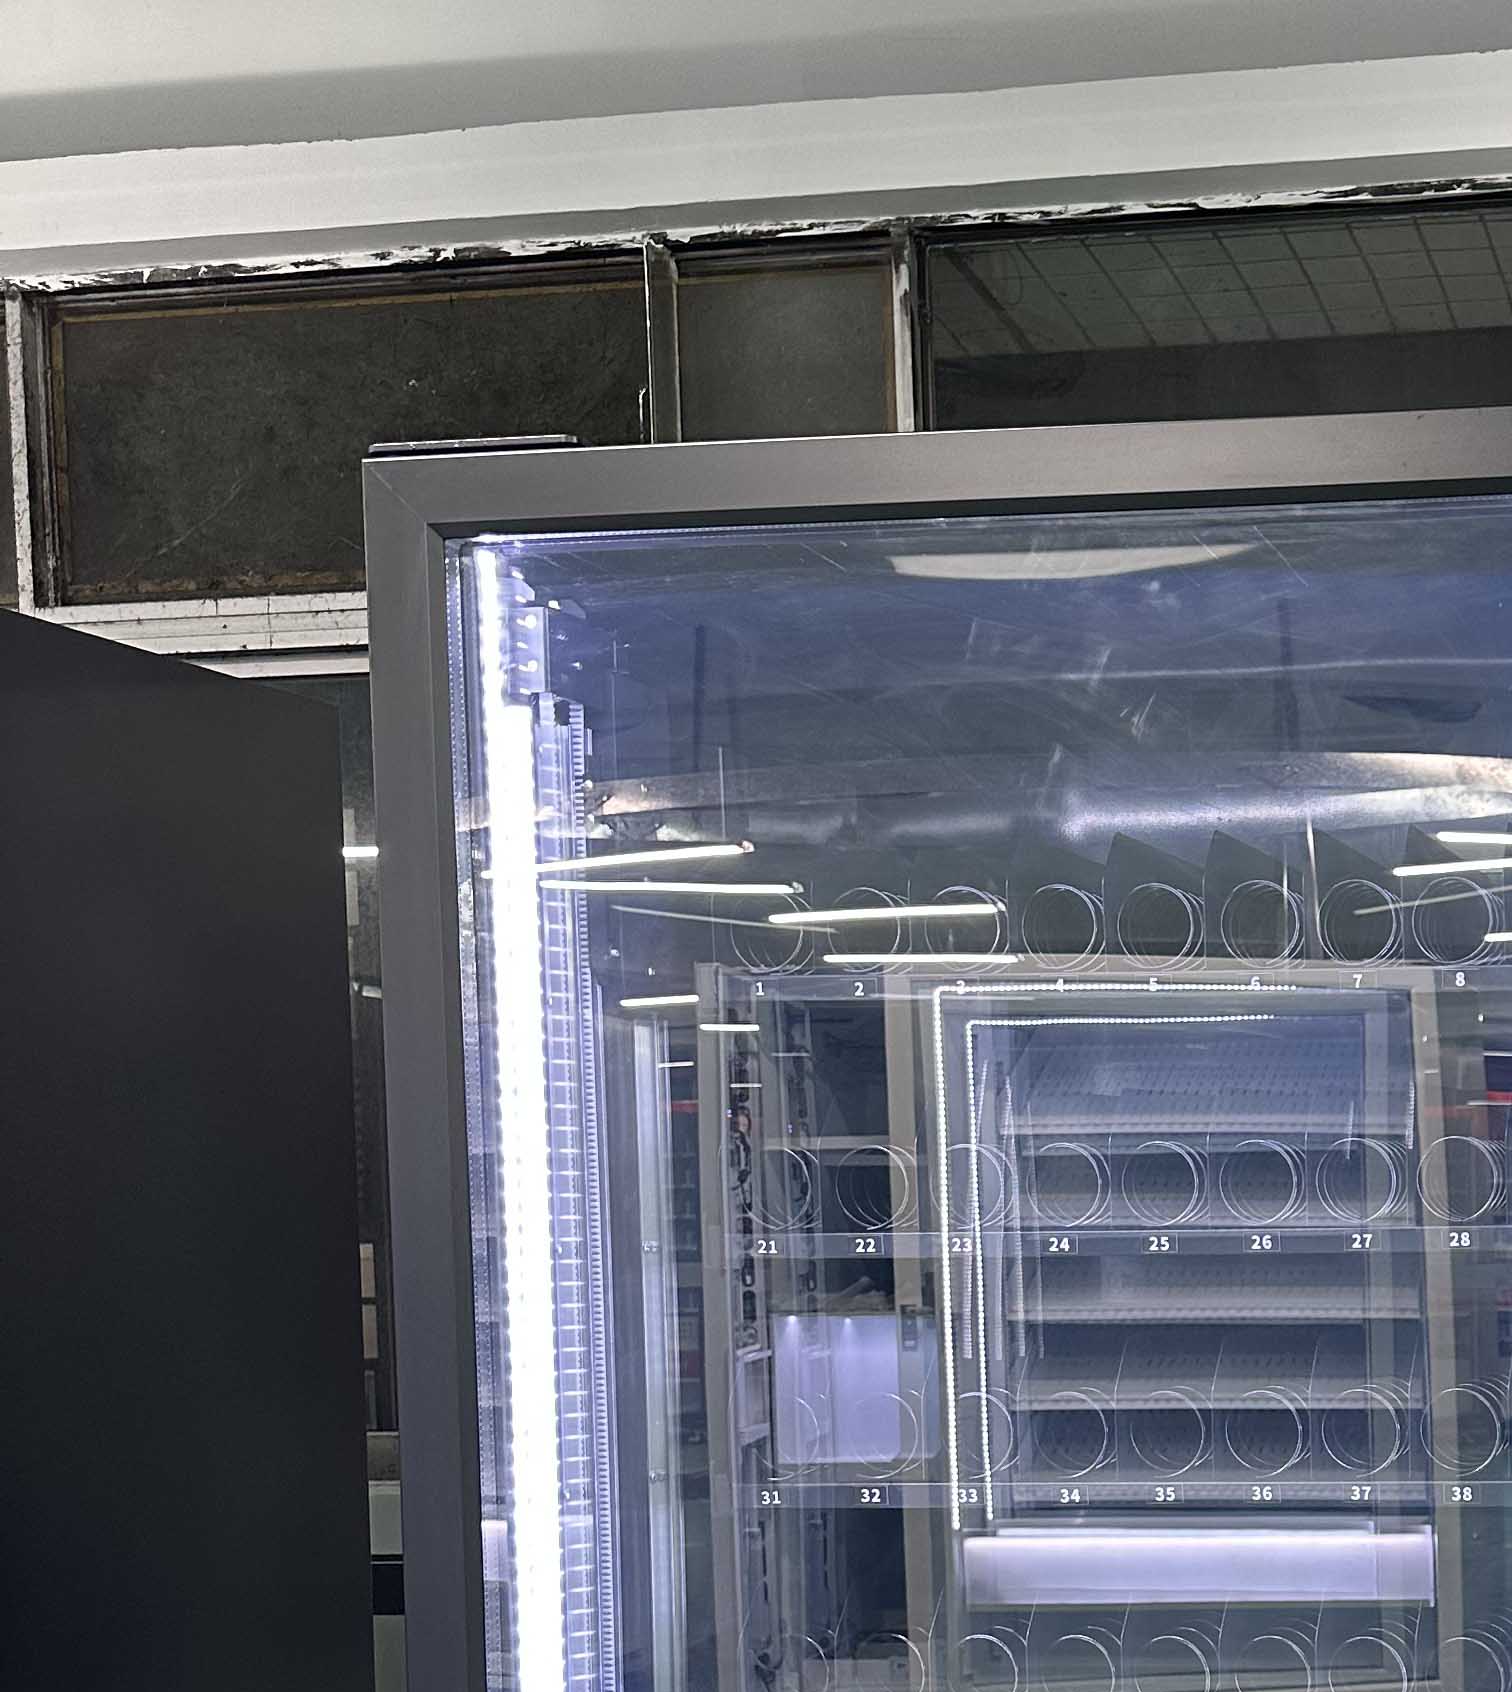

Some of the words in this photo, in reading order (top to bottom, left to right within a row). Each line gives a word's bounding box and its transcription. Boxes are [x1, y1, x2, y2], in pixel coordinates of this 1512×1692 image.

[1055, 979, 1065, 993] 4
[1149, 977, 1158, 991] 5
[1250, 976, 1260, 990] 6
[1352, 973, 1363, 989] 7
[1455, 971, 1466, 987] 8
[756, 981, 765, 996] 1
[854, 981, 865, 996] 2
[957, 981, 966, 994] 3
[855, 1238, 876, 1253] 22
[952, 1238, 972, 1253] 23
[1049, 1237, 1070, 1252] 24
[1149, 1236, 1170, 1251] 25
[1251, 1234, 1272, 1250] 26
[1351, 1233, 1373, 1249] 27
[1449, 1231, 1471, 1247] 28
[757, 1240, 778, 1254] 21
[761, 1490, 781, 1505] 31
[861, 1488, 881, 1503] 32
[958, 1488, 978, 1503] 33
[1060, 1488, 1081, 1503] 34
[1155, 1486, 1176, 1502] 35
[1252, 1486, 1273, 1501] 36
[1350, 1485, 1372, 1501] 37
[1451, 1486, 1473, 1501] 38
